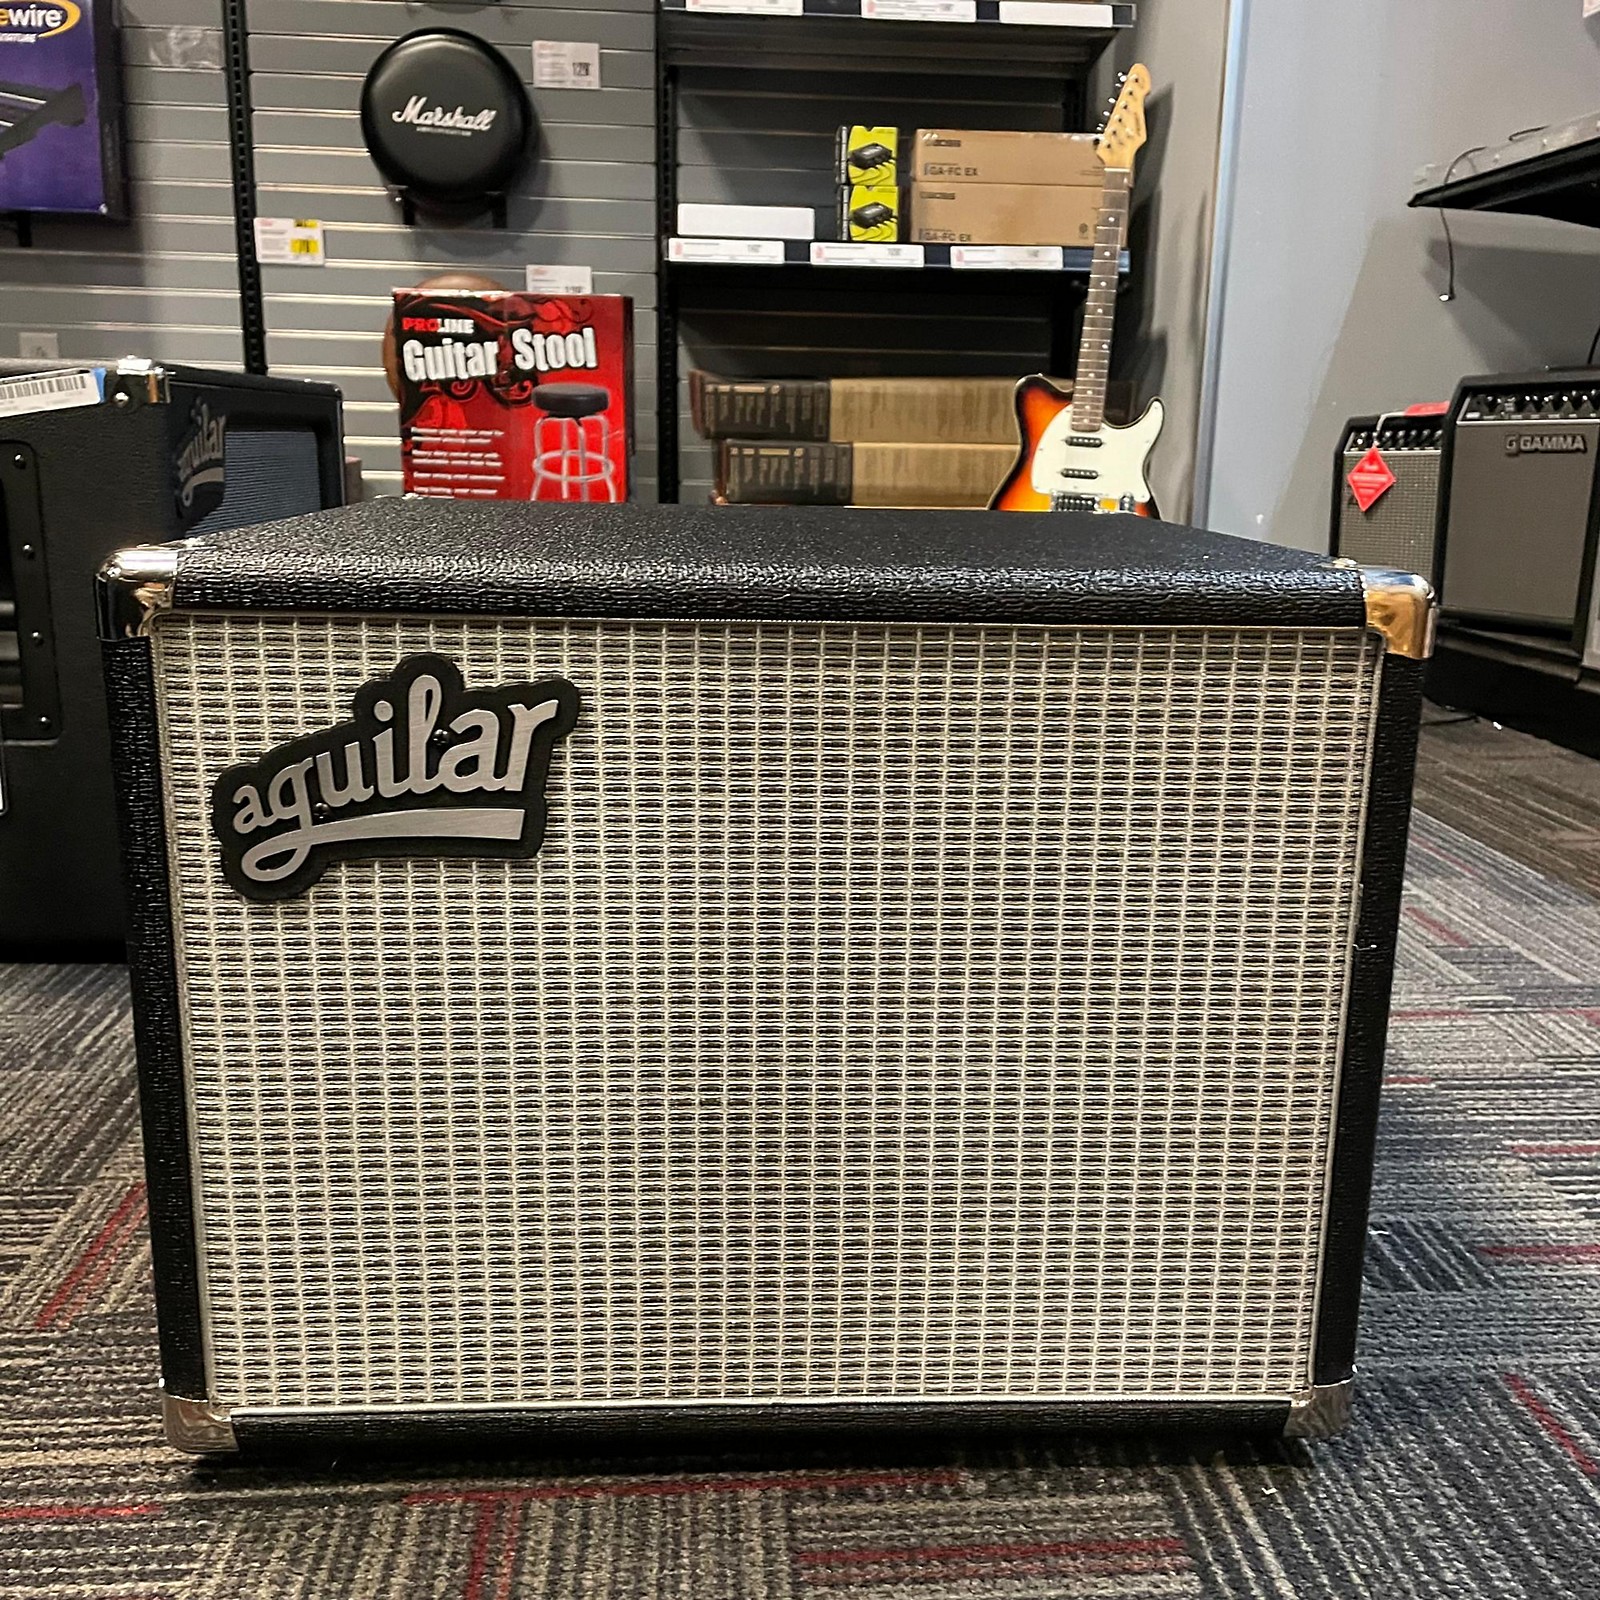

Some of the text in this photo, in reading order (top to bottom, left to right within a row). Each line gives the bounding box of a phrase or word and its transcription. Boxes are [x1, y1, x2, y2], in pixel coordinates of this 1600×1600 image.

[392, 95, 497, 131] Marshall
[402, 327, 598, 381] Guitar Stool
[1520, 435, 1586, 451] GAMMA
[232, 674, 560, 882] aguilar
